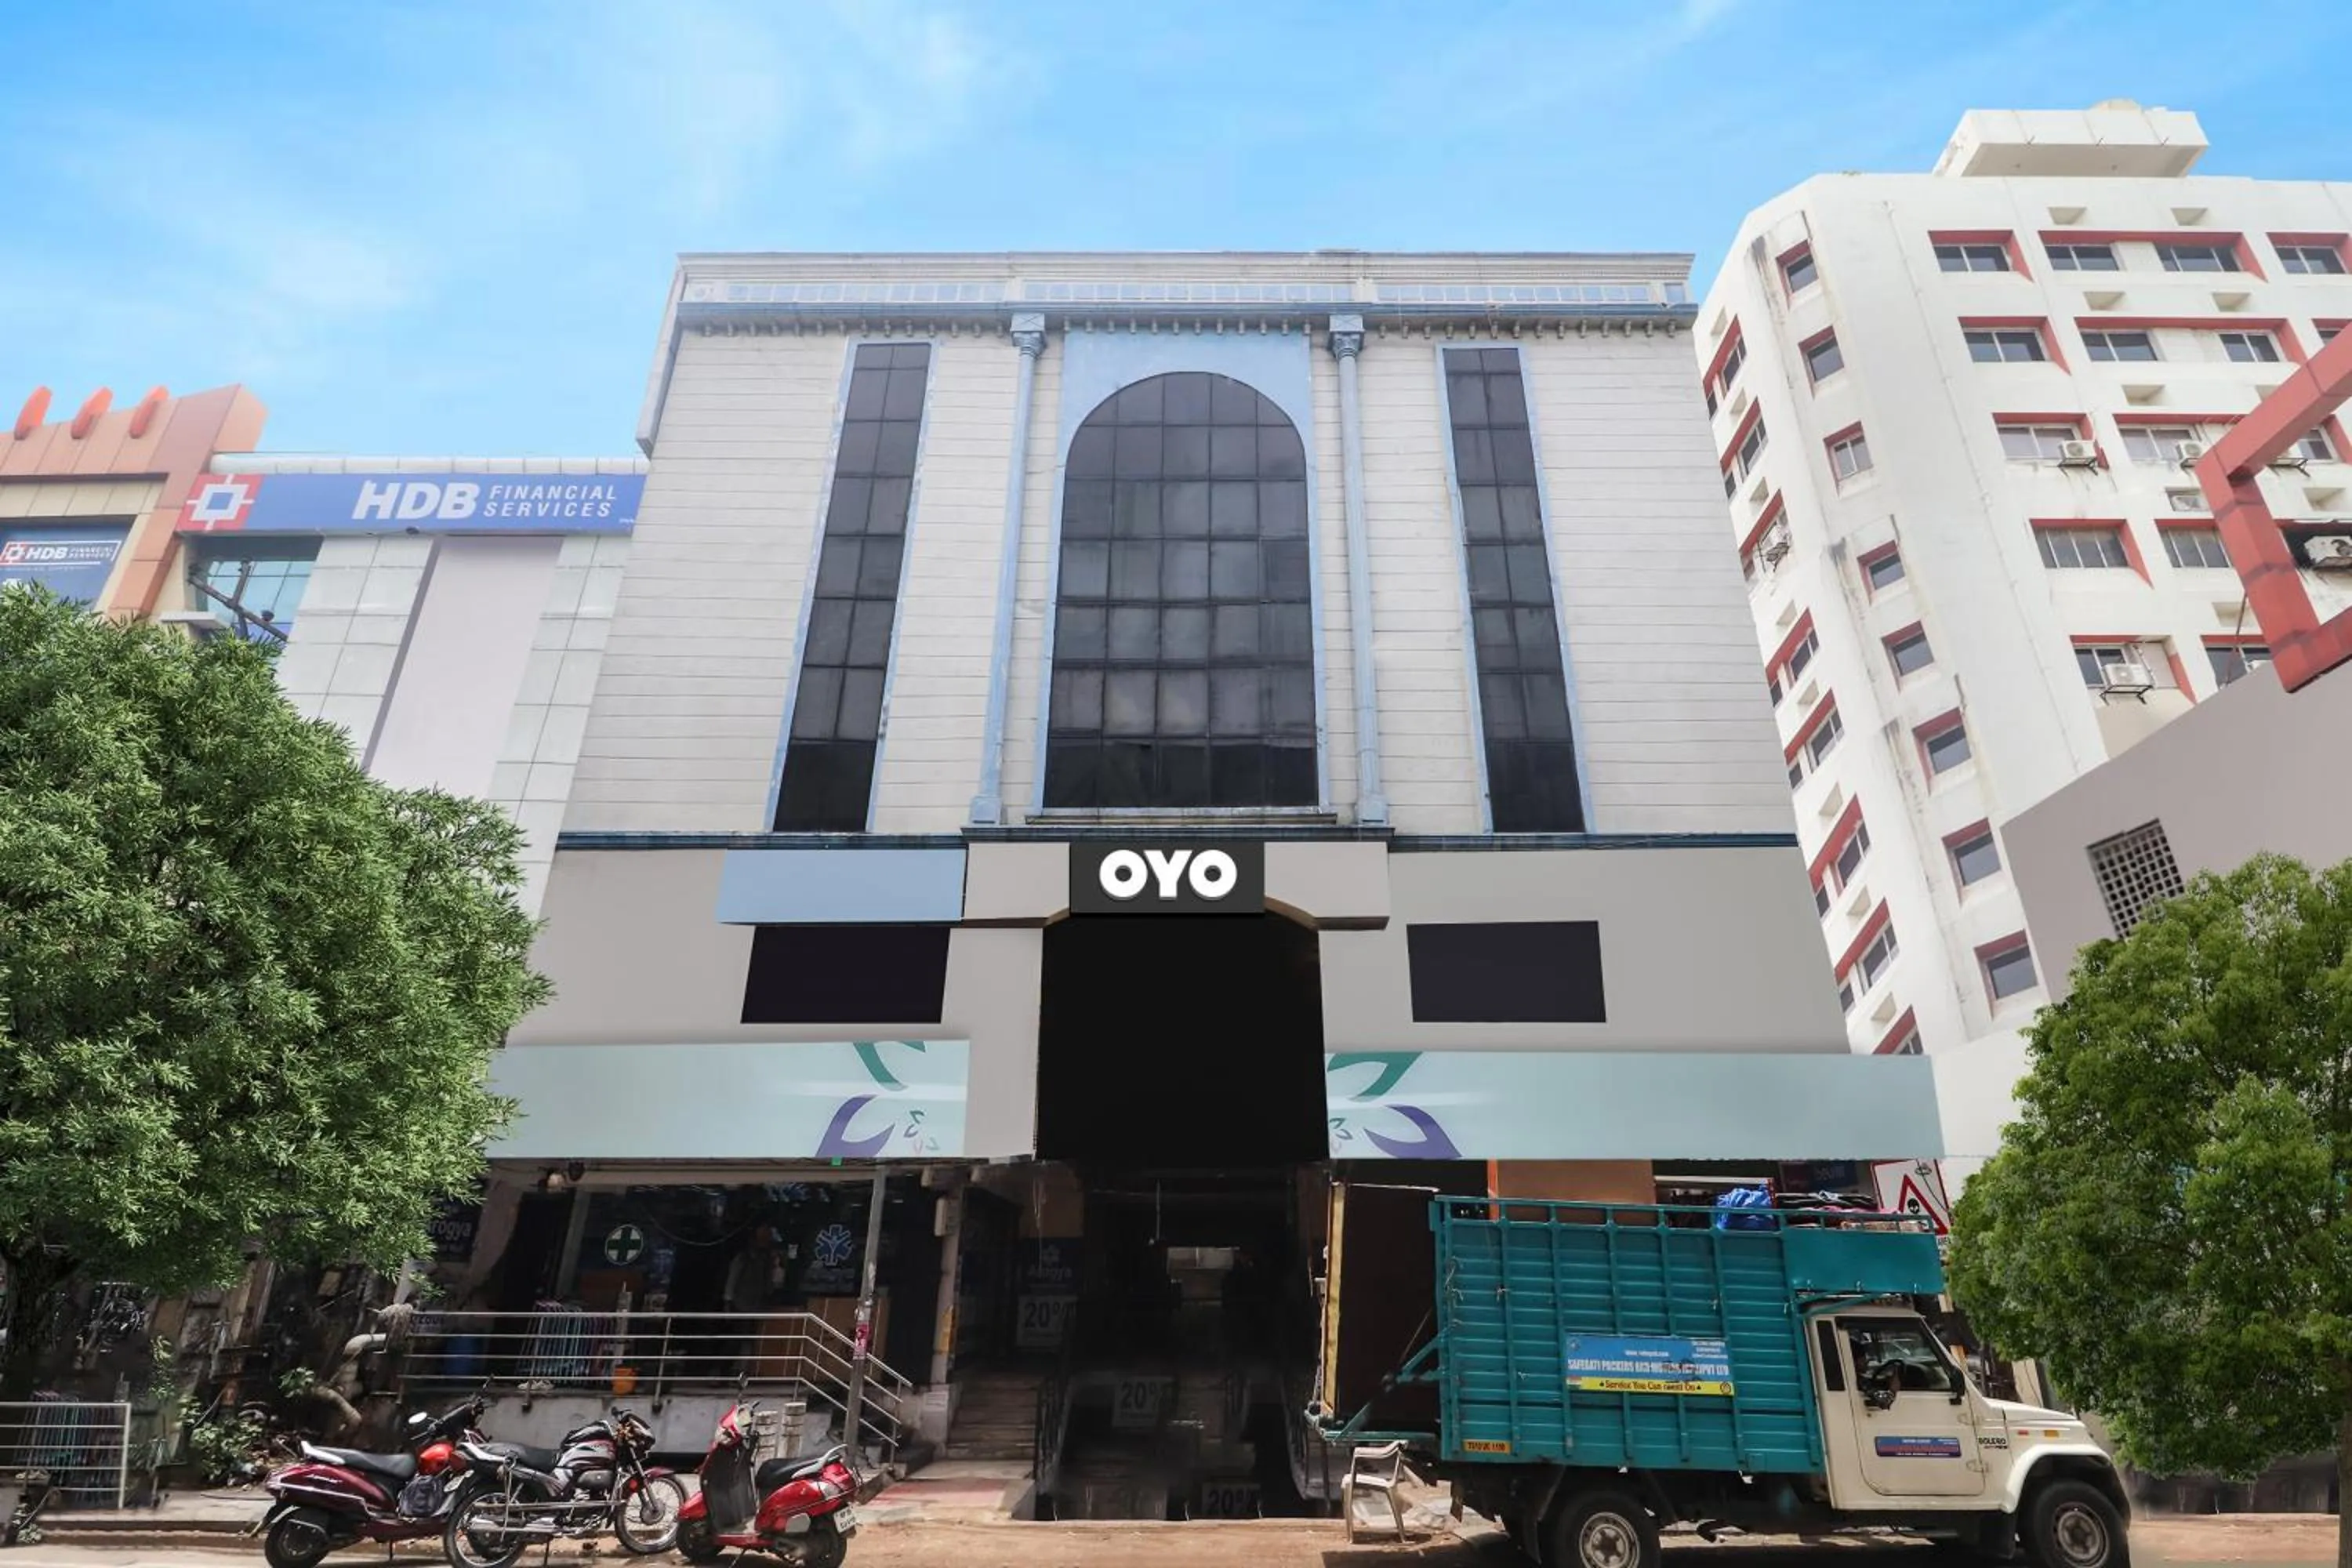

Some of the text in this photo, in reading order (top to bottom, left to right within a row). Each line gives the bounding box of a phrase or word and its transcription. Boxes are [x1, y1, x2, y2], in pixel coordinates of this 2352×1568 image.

[351, 479, 481, 519] HDB
[489, 485, 617, 500] FINANCIAL
[483, 501, 612, 517] SERVICES
[25, 546, 67, 560] HDB
[1099, 849, 1238, 901] OYO
[430, 1220, 473, 1241] rogya
